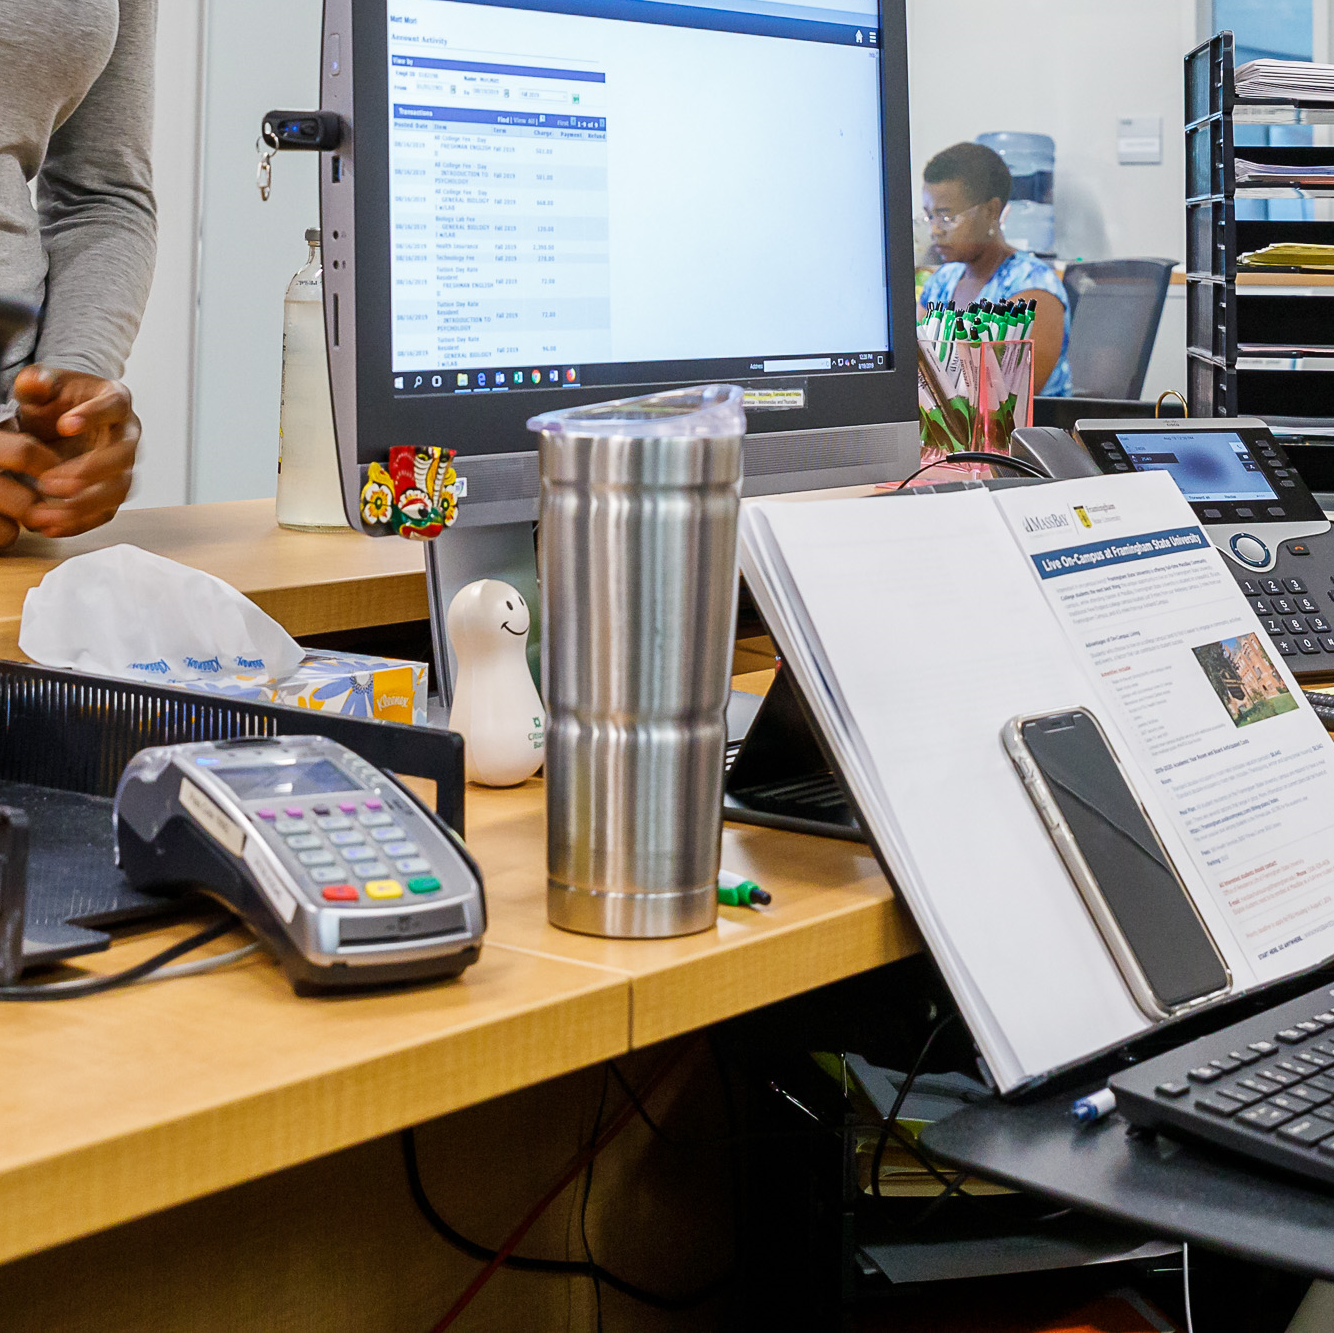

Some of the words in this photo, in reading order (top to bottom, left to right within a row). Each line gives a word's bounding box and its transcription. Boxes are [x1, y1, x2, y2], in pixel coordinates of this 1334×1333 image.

[391, 34, 419, 42] Account
[421, 36, 447, 46] Activity
[398, 107, 433, 117] Transactions
[1041, 558, 1061, 572] Live
[1062, 548, 1105, 568] On-Campus
[1105, 548, 1111, 559] at
[1111, 541, 1153, 557] Framingham
[1152, 538, 1170, 550] State
[1170, 532, 1202, 547] University
[1268, 580, 1276, 589] 2
[1290, 579, 1298, 587] 3
[1279, 600, 1287, 608] 5
[1302, 598, 1310, 606] 6
[1268, 620, 1274, 628] 7
[1291, 619, 1299, 628] 8
[1314, 618, 1322, 626] 9
[1303, 638, 1311, 647] 0
[185, 656, 223, 673] Kleenex
[377, 694, 409, 712] Kleenex
